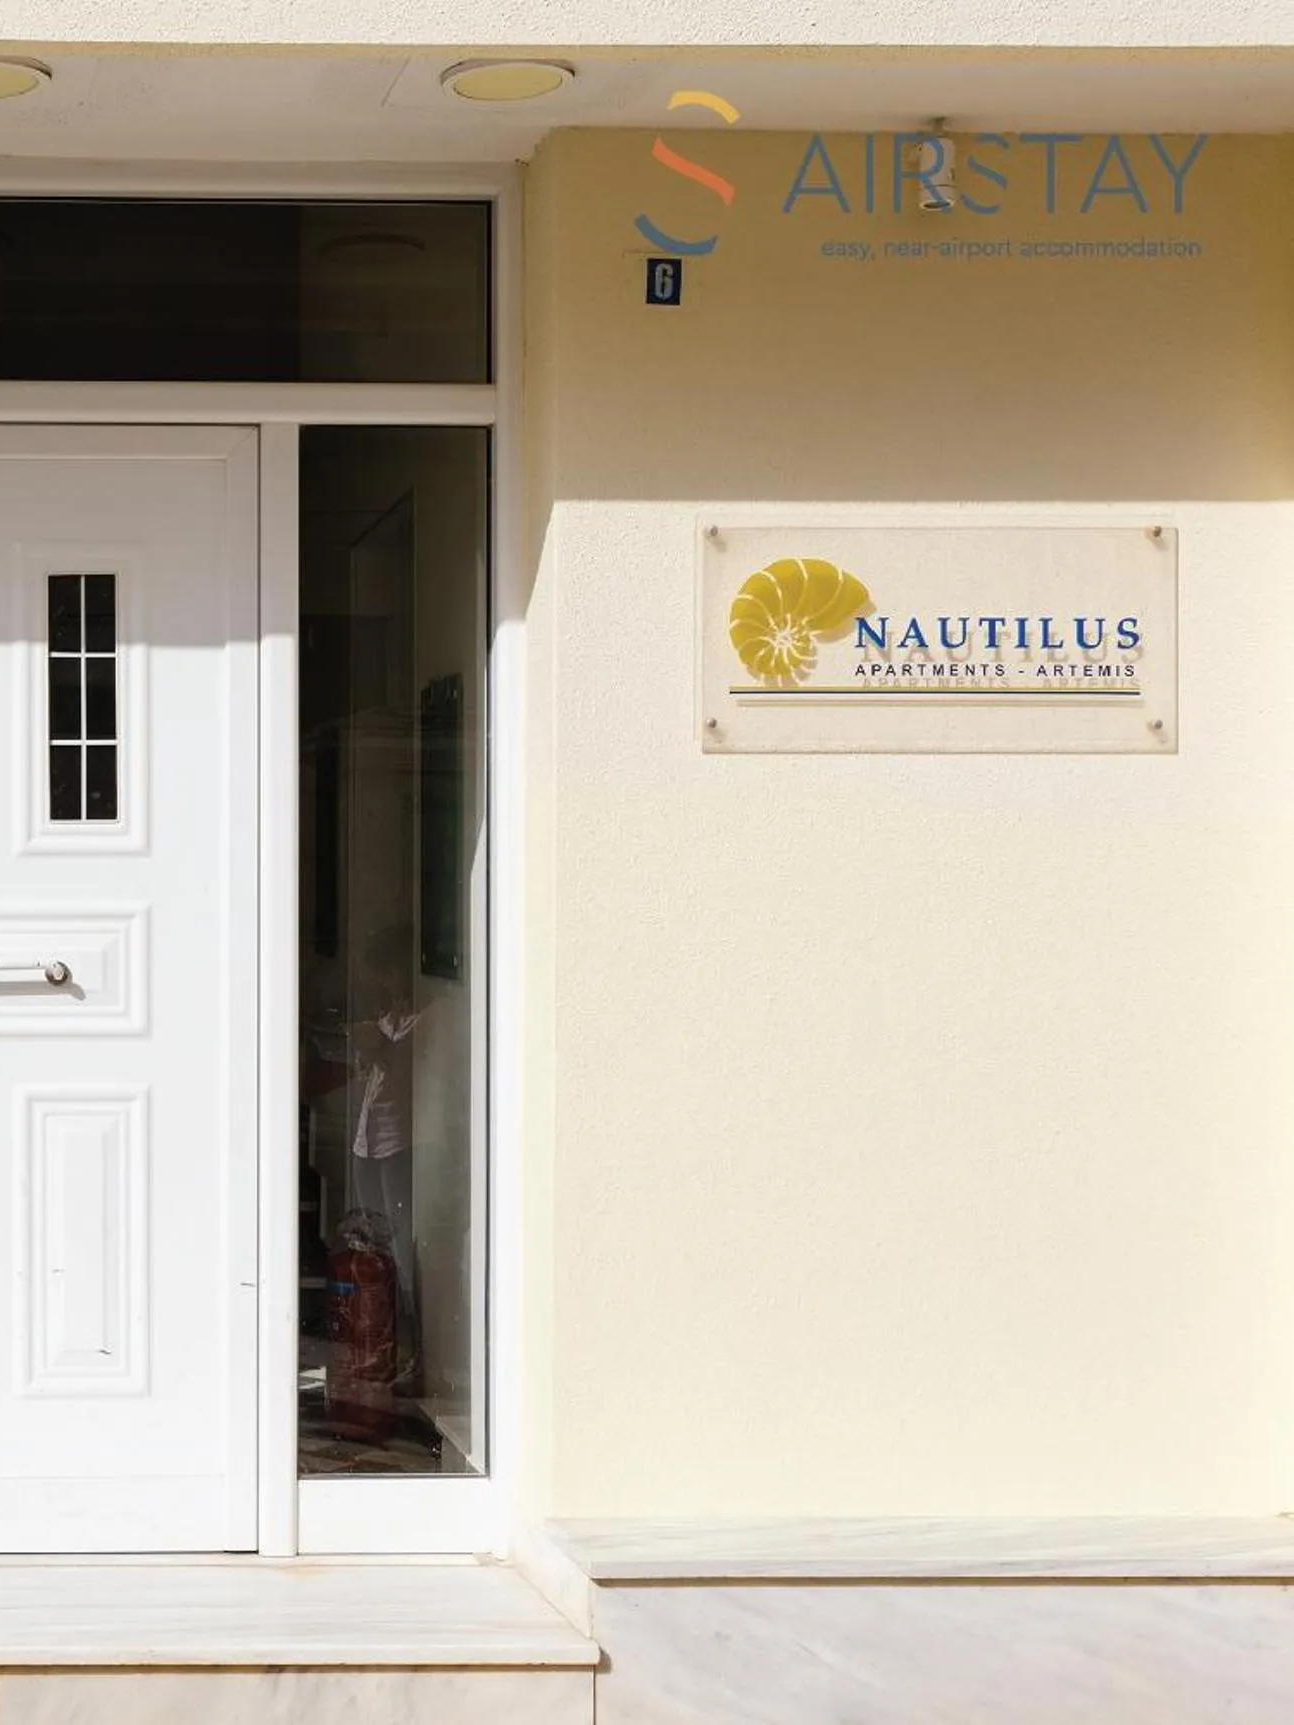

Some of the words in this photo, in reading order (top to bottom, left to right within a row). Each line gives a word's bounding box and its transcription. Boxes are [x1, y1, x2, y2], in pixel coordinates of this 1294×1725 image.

[654, 263, 674, 301] 6
[854, 616, 1141, 650] NAUTILUS
[855, 663, 1006, 677] APARTMENTS
[1036, 664, 1136, 677] ARTEMIS
